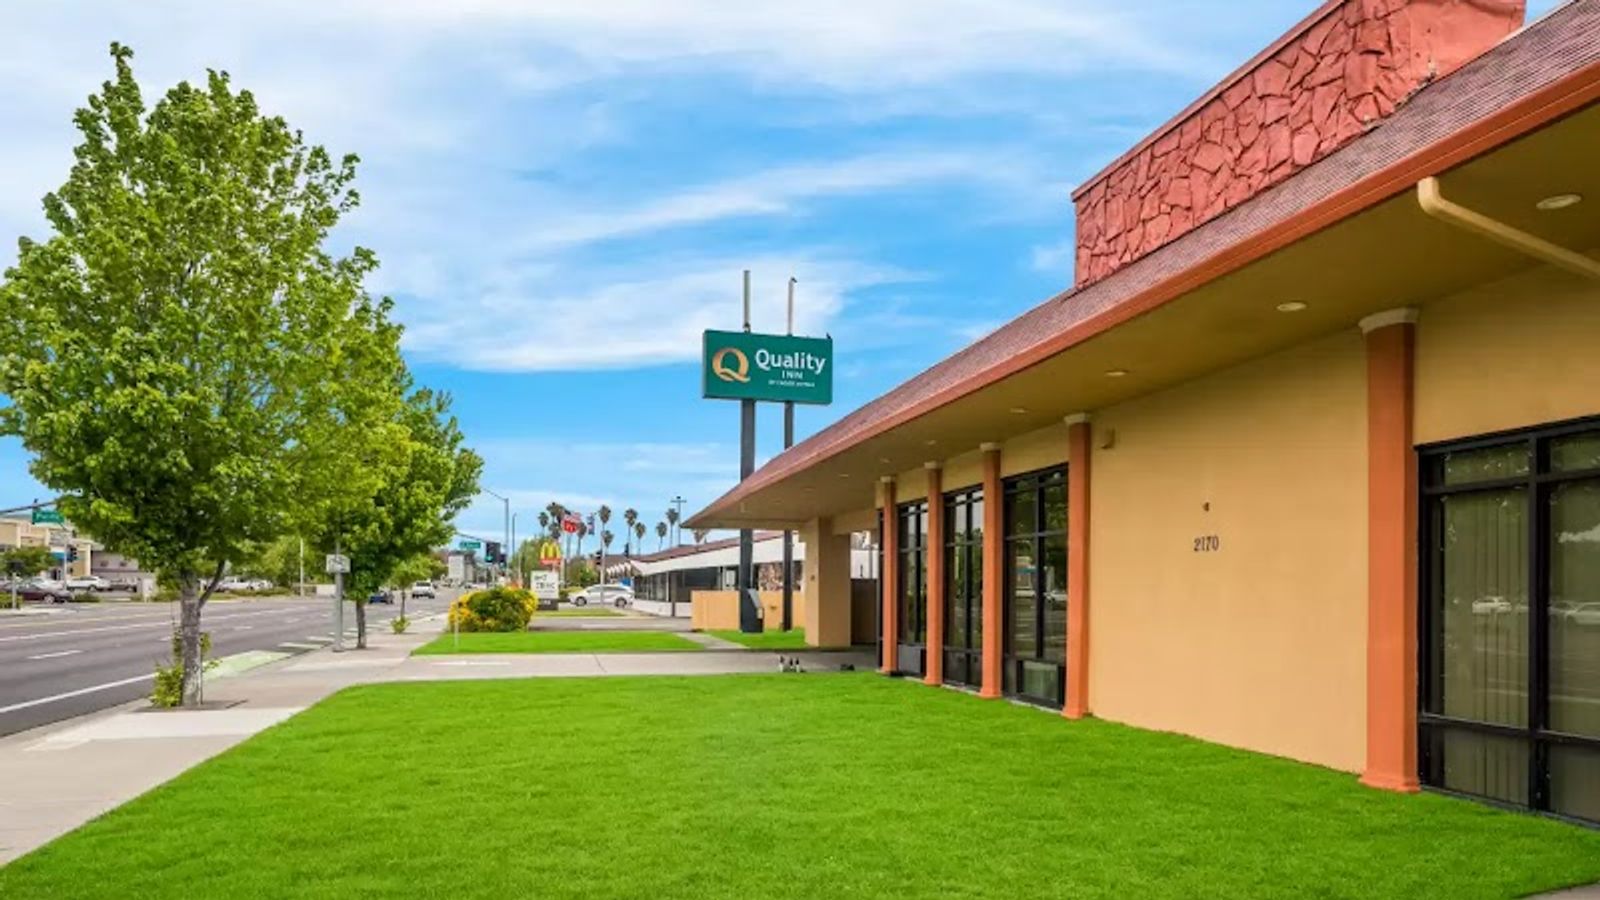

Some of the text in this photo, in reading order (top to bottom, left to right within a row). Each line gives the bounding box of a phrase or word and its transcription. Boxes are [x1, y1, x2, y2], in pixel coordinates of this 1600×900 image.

[712, 348, 750, 382] Q
[755, 349, 825, 374] Quality
[782, 370, 803, 379] INN
[1193, 536, 1219, 551] 2170
